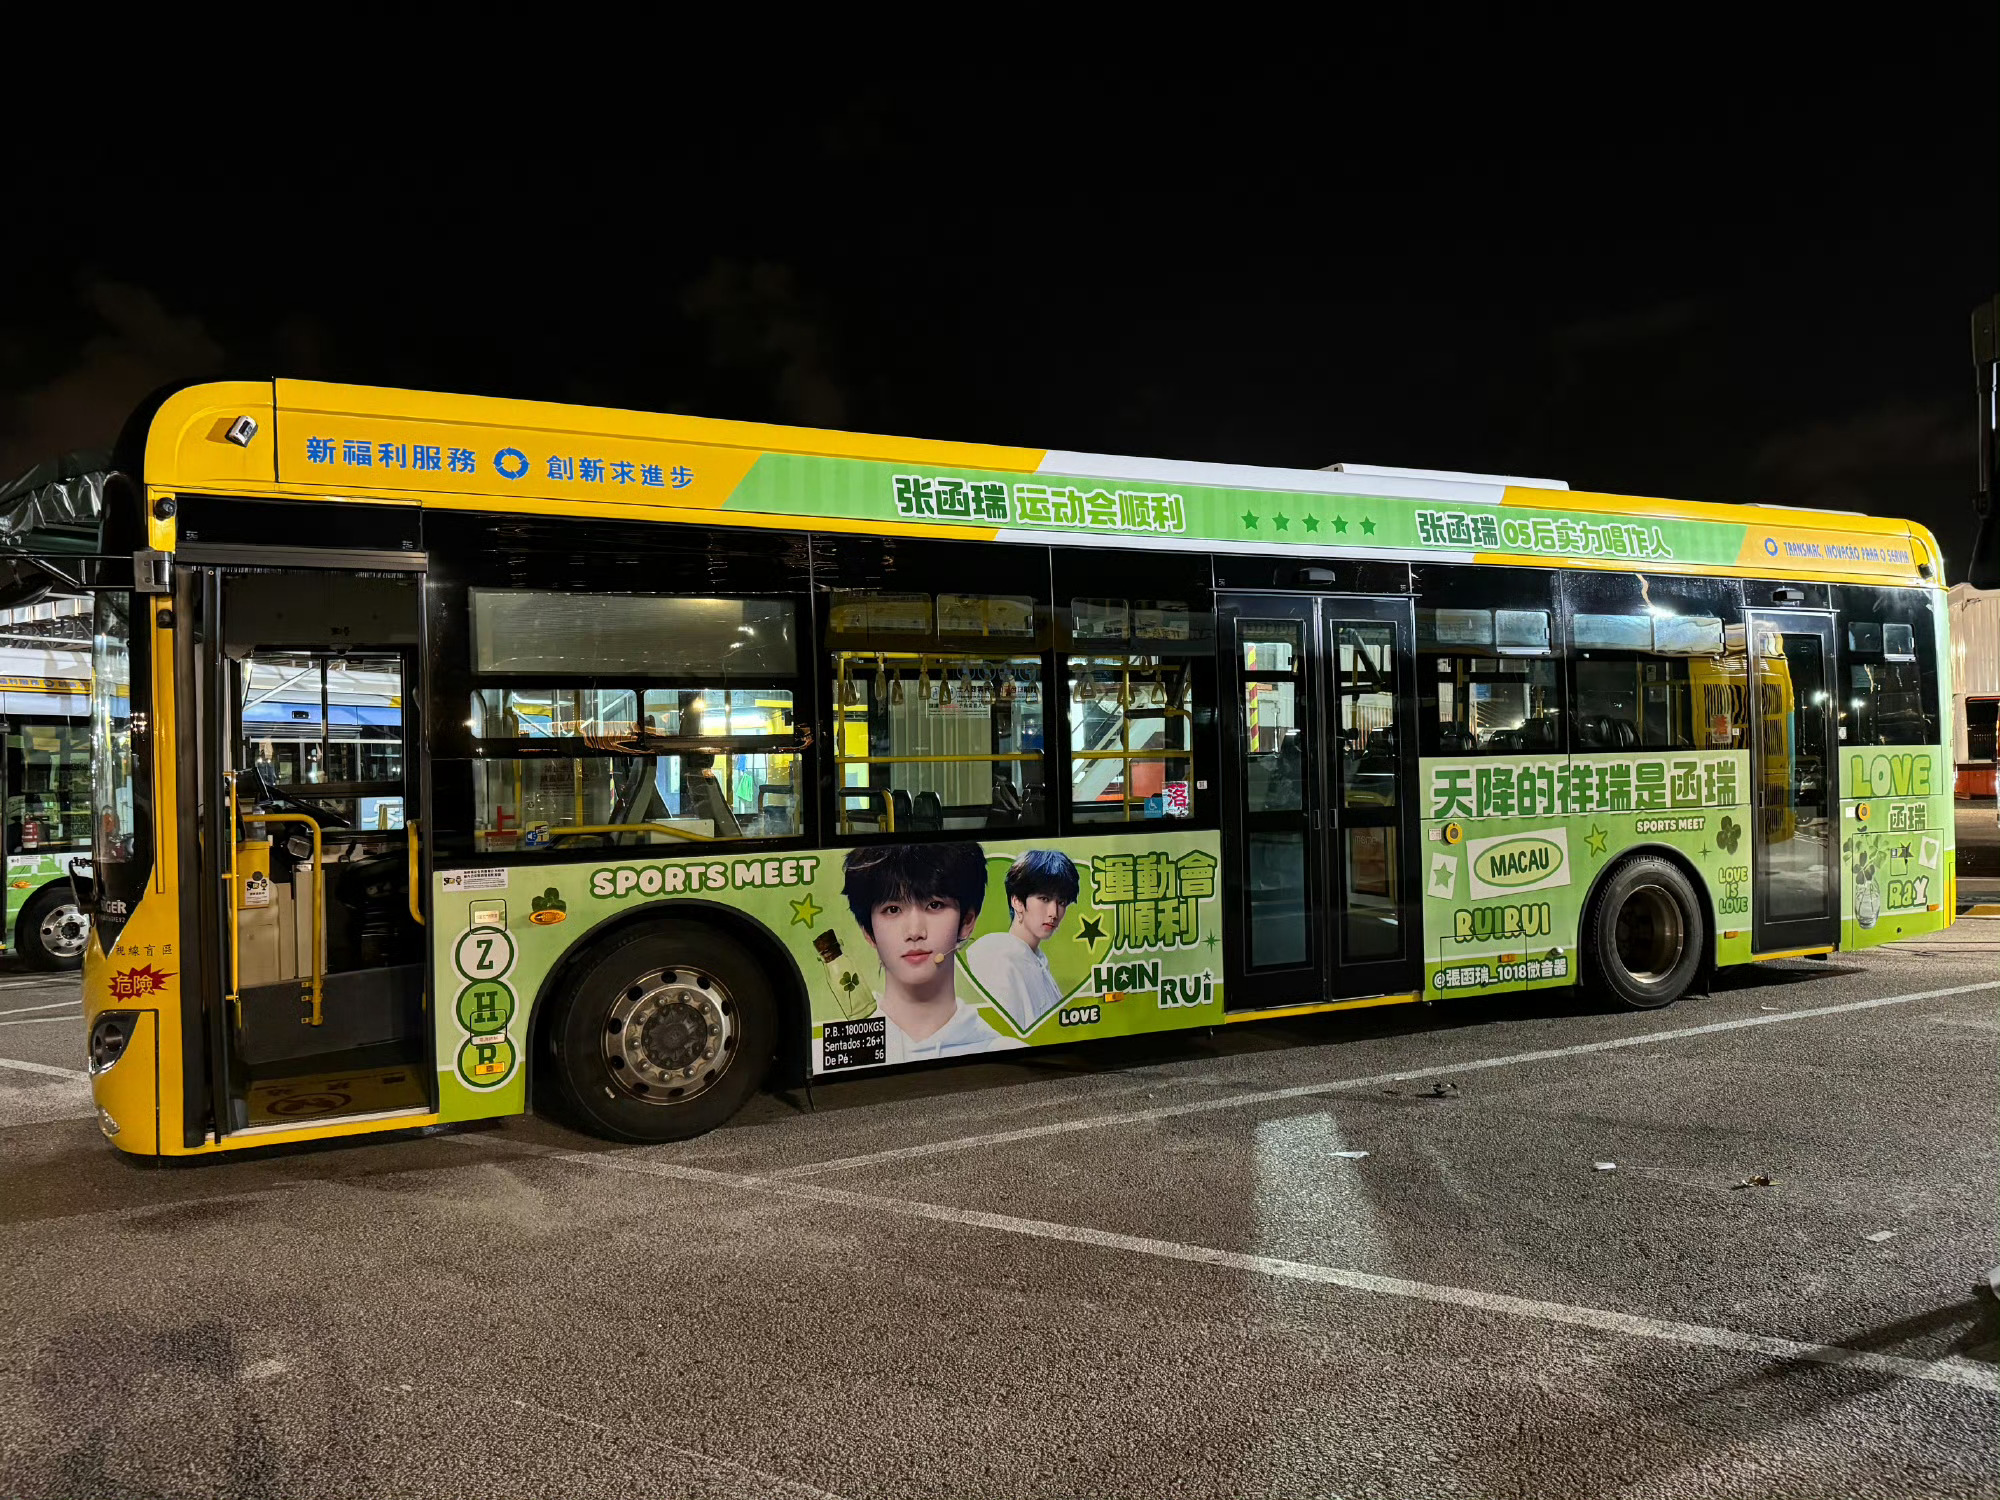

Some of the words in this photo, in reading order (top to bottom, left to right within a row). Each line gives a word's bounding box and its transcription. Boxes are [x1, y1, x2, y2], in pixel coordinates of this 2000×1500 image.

[306, 435, 477, 474] 新福利服務
[546, 454, 695, 489] 創新求進步
[895, 476, 1009, 521] 张函瑞
[1015, 485, 1185, 533] 运动会顺利
[1417, 511, 1499, 548] 张函瑞
[1502, 516, 1673, 559] 05后实力唱作人
[1432, 760, 1737, 818] 天降的祥瑞是函瑞
[1851, 754, 1931, 797] LOVE
[1636, 819, 1677, 833] SPORTS
[1678, 817, 1705, 831] MEET
[1890, 803, 1926, 830] 函瑞
[591, 863, 726, 897] SPORTS
[733, 857, 818, 890] MEET
[1092, 852, 1217, 903] 運動會
[1490, 847, 1549, 878] MACAU
[1718, 866, 1748, 884] LOVE
[1719, 897, 1748, 914] LOVE
[1725, 882, 1739, 899] IS
[1114, 898, 1200, 948] 順利
[1454, 903, 1551, 942] RUIRUI
[476, 939, 494, 970] Z
[116, 975, 153, 994] 危險
[474, 990, 498, 1024] H
[1060, 1006, 1100, 1026] LOVE
[845, 1021, 884, 1036] 18000KGS
[866, 1035, 884, 1047] 26+1
[825, 1056, 836, 1066] De
[874, 1049, 884, 1060] 56
